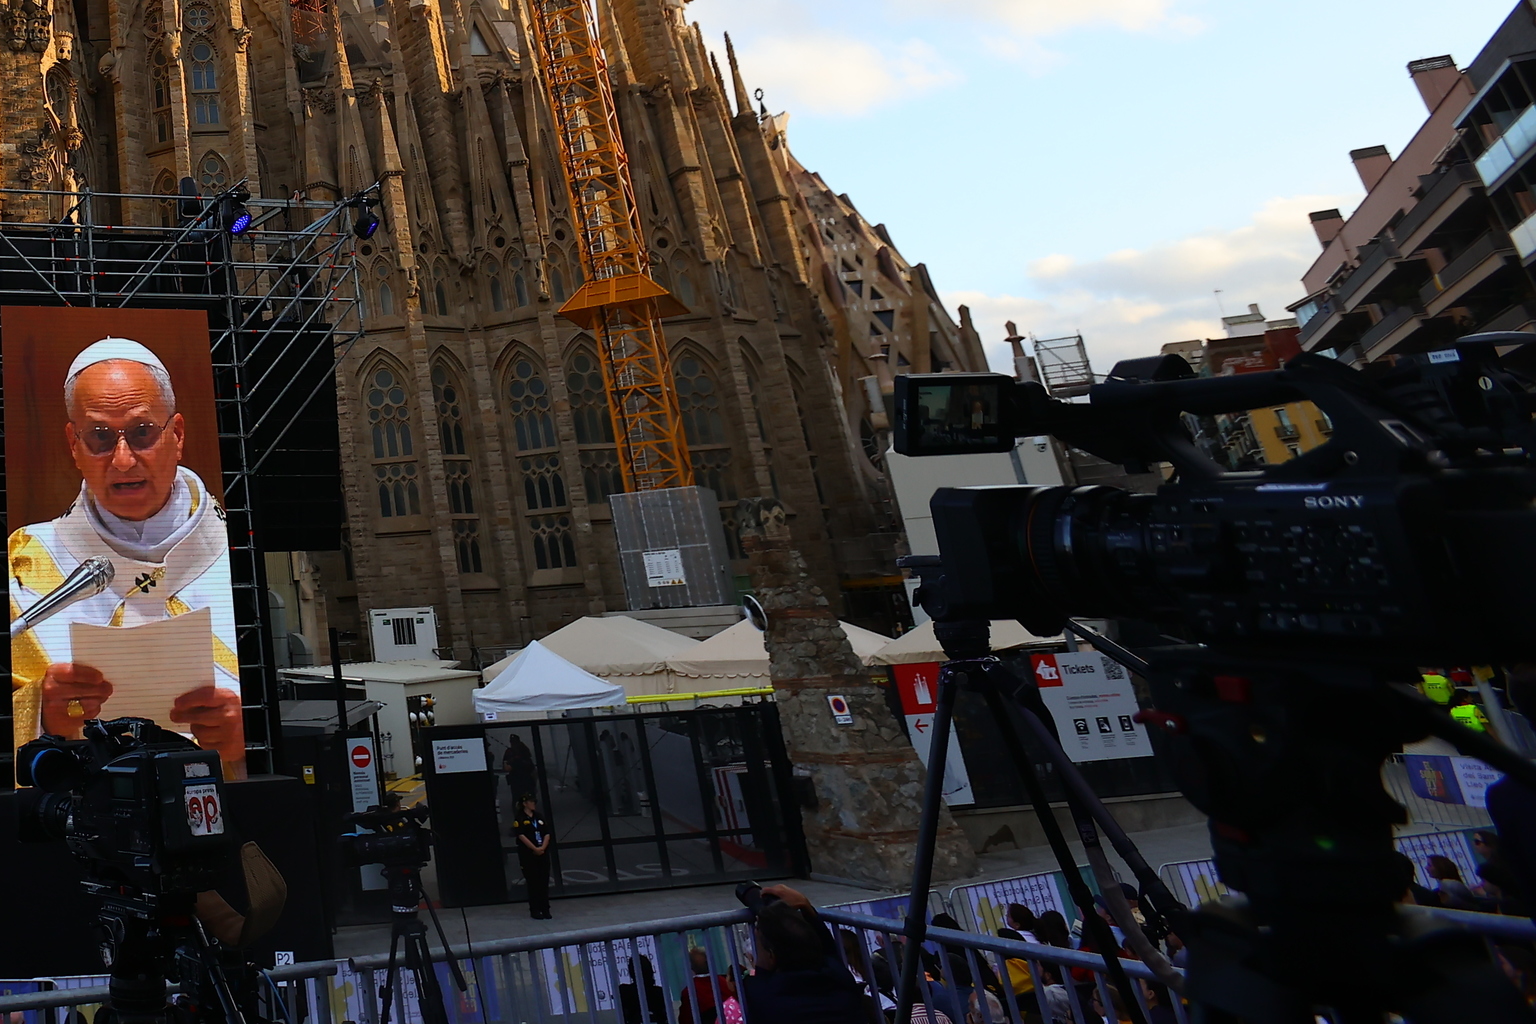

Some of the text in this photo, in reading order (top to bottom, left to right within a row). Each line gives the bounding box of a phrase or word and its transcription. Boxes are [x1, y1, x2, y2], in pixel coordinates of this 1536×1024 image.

[1303, 495, 1364, 509] SONY
[1062, 664, 1095, 675] Tickets
[277, 953, 290, 965] P2
